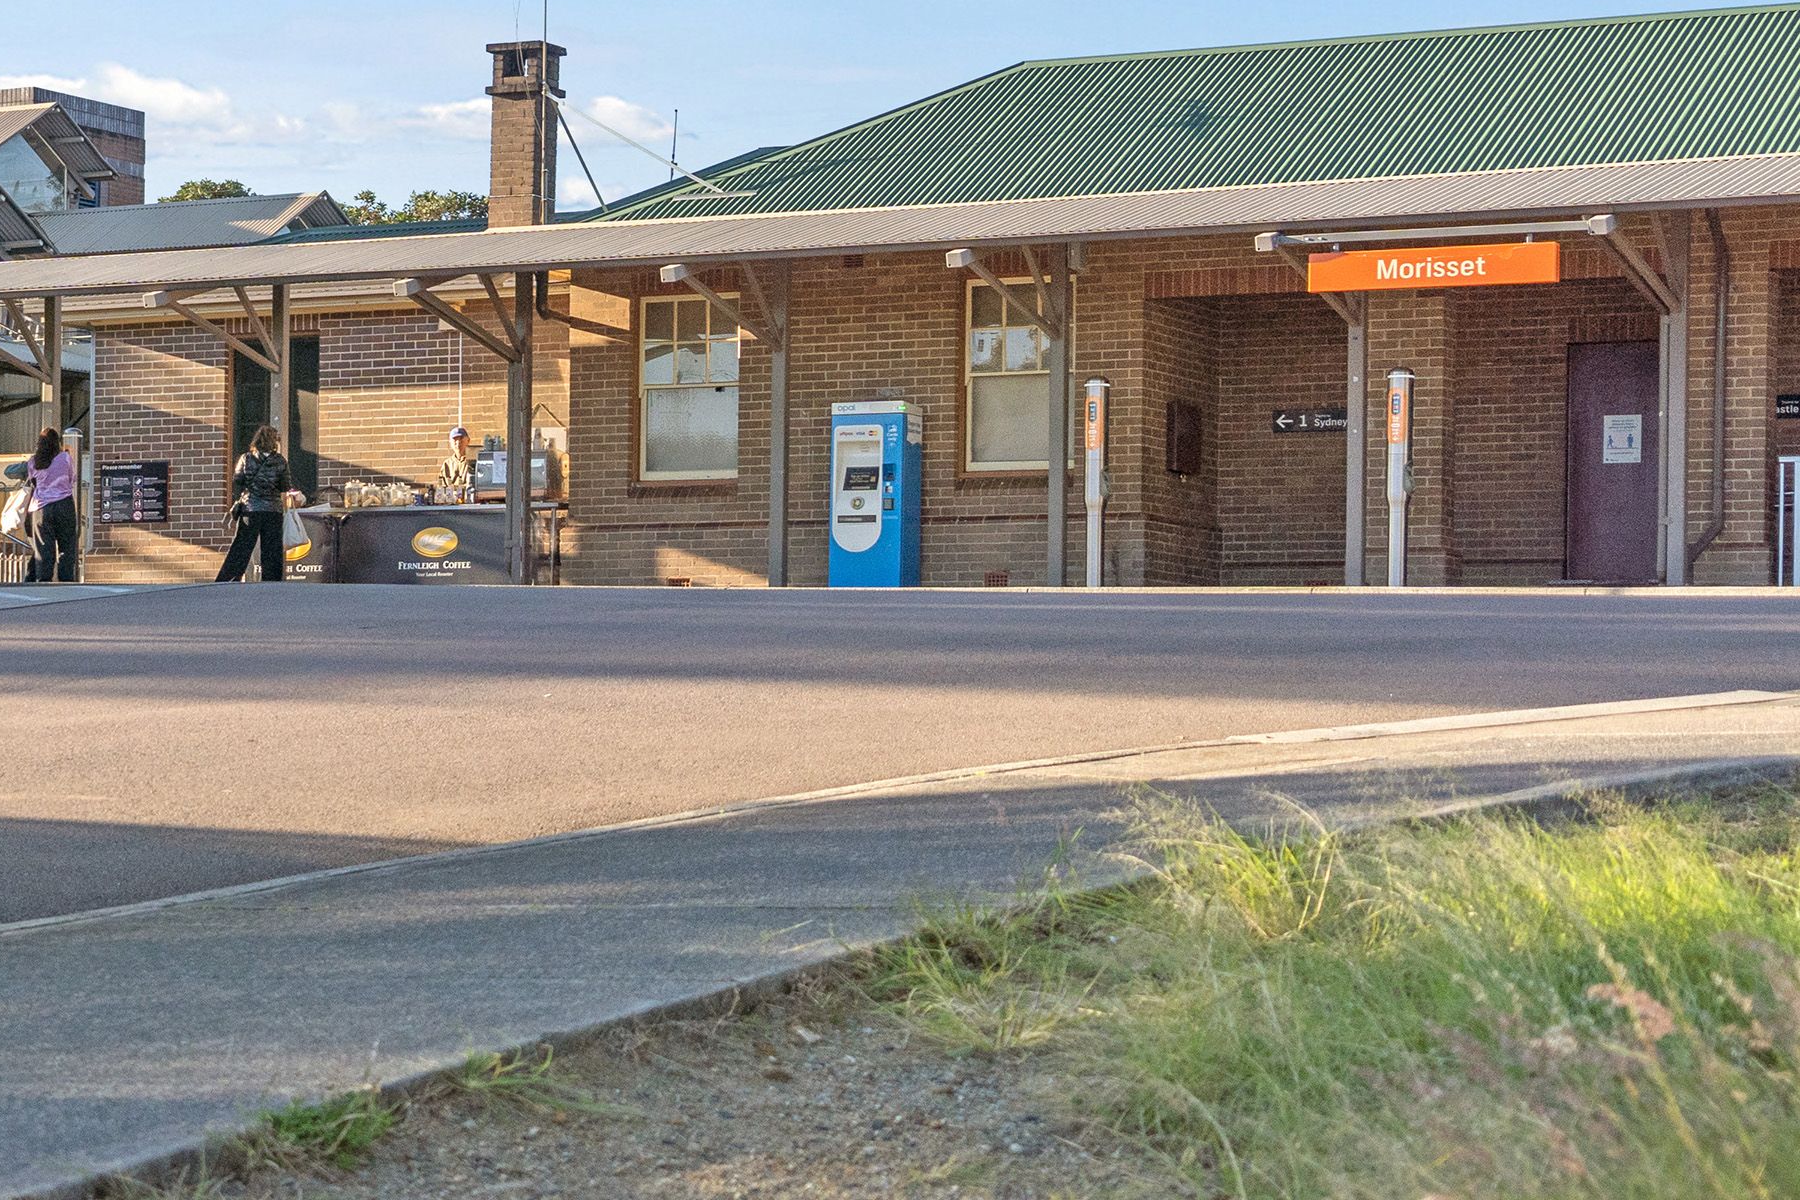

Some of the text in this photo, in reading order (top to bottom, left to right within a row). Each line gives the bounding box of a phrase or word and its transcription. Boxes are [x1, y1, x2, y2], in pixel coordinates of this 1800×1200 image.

[1376, 256, 1486, 280] Morisset
[1299, 414, 1308, 427] 1
[1314, 418, 1348, 428] Sydney
